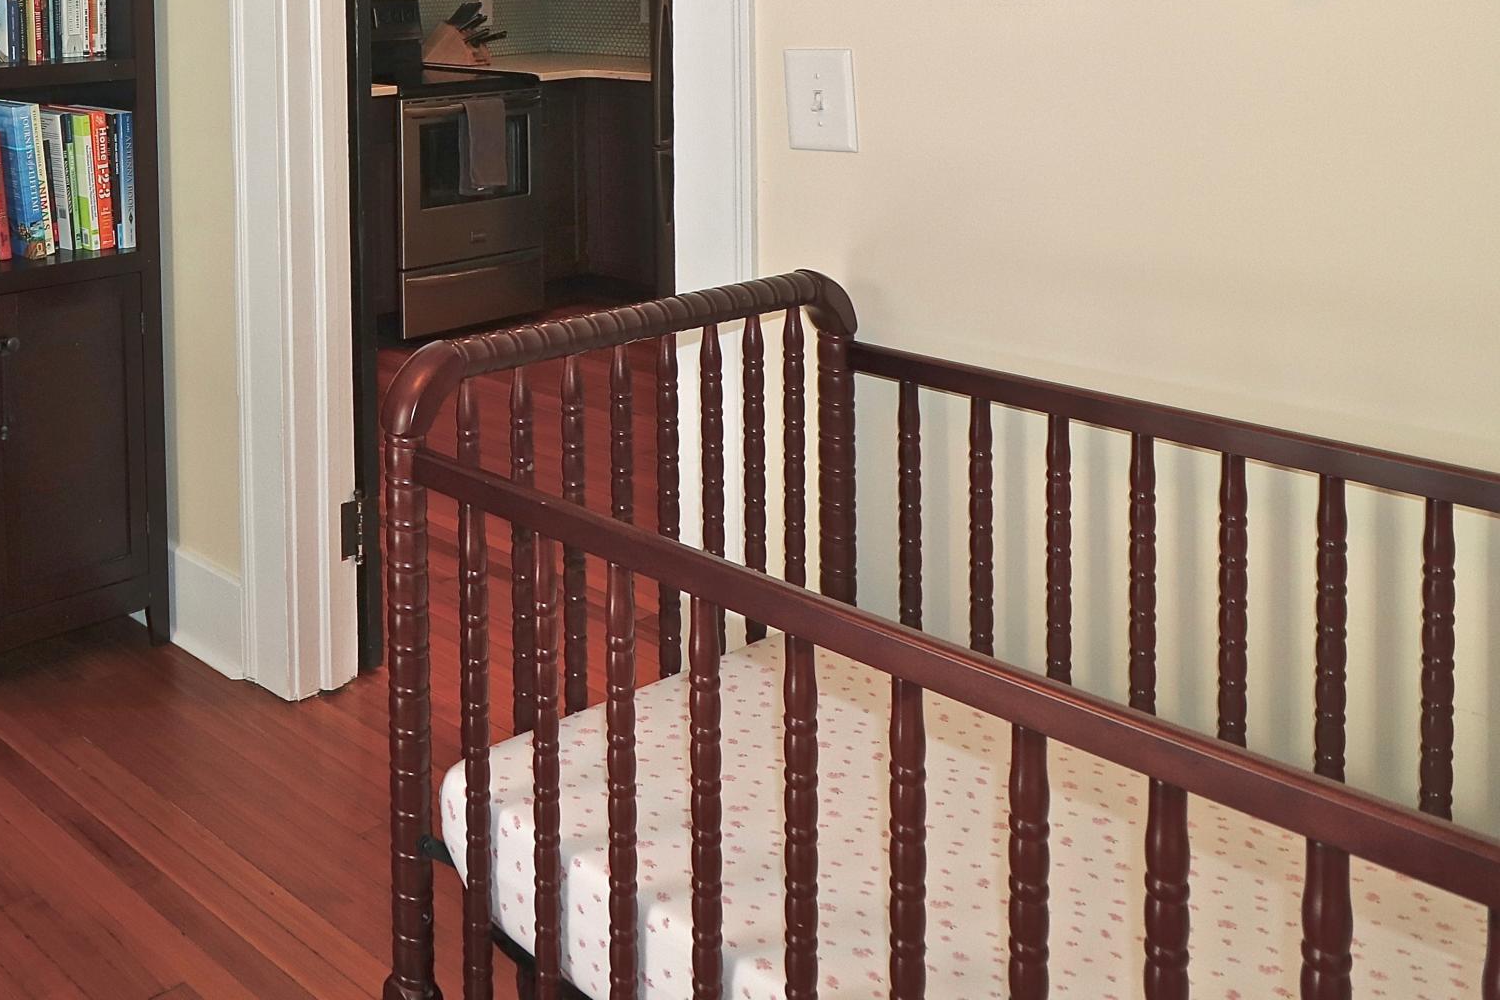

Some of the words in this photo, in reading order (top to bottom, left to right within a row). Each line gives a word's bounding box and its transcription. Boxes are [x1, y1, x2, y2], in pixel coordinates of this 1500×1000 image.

[21, 115, 33, 159] JOURNEYS
[29, 170, 38, 214] LIFETIME
[99, 127, 109, 160] Home
[125, 135, 133, 182] ANTENNA
[34, 124, 42, 166] ENCYCLOPEDIA
[38, 180, 50, 230] ANIMALS
[98, 162, 110, 198] 1-2-3
